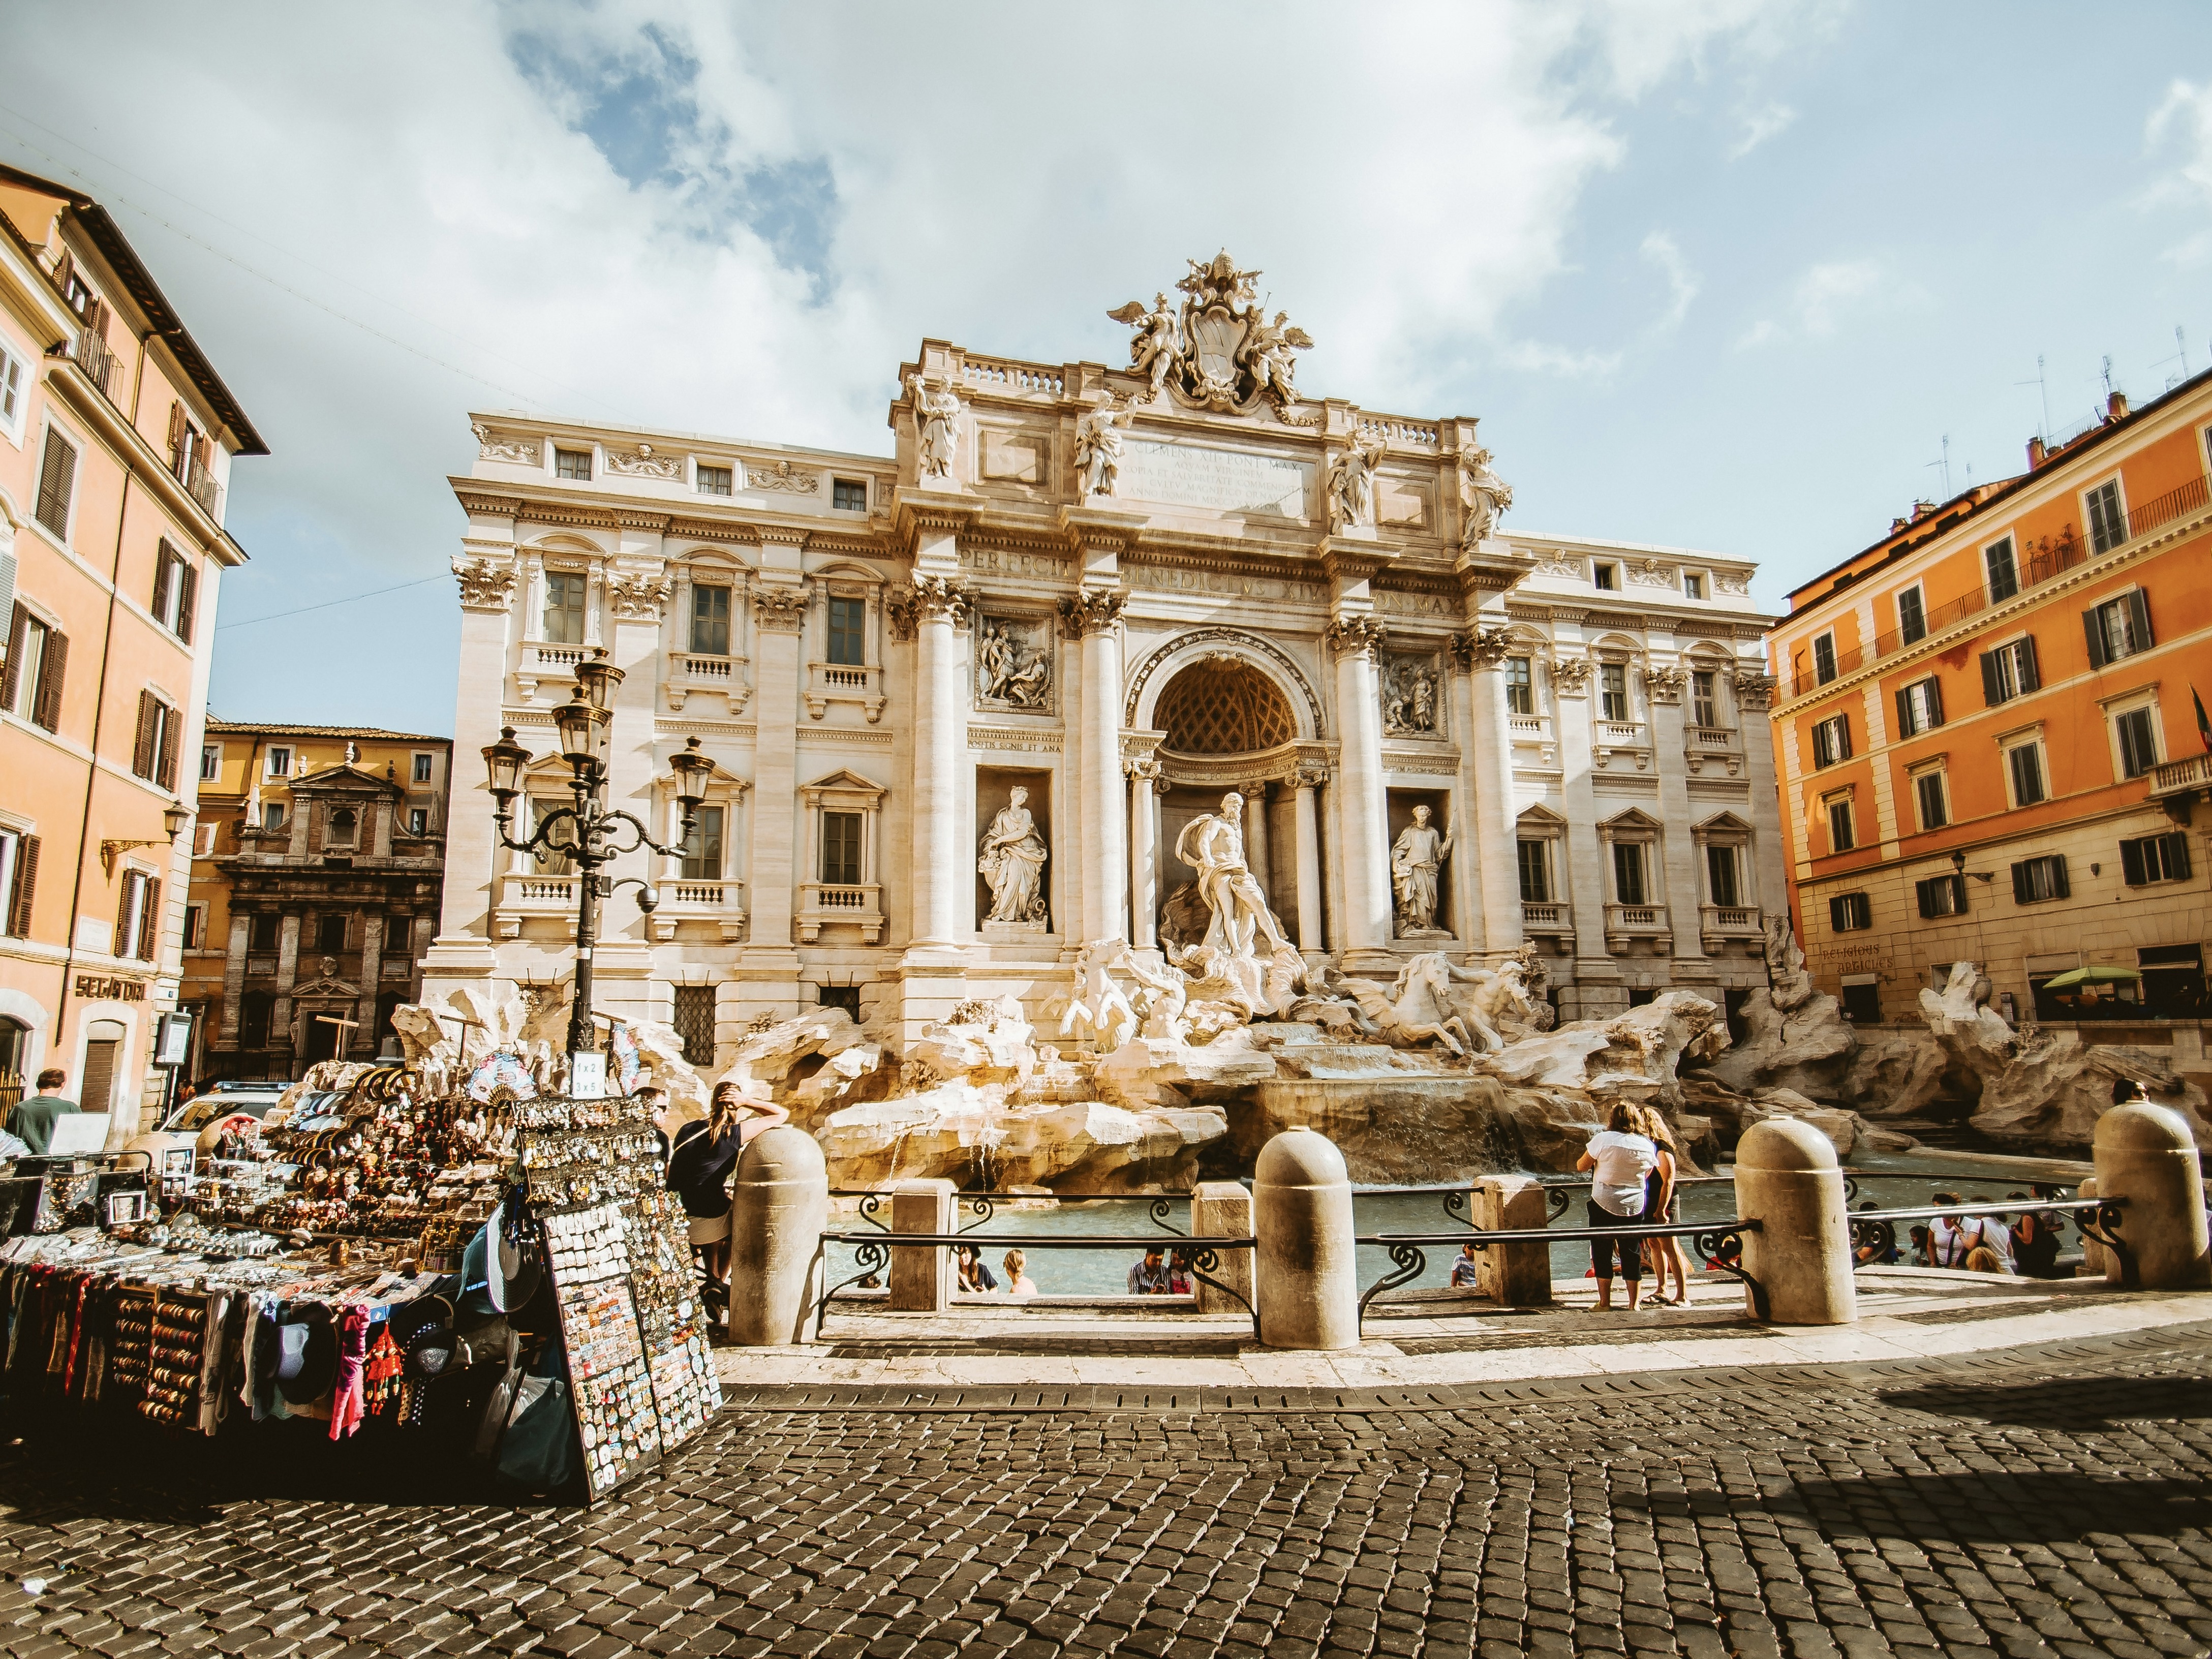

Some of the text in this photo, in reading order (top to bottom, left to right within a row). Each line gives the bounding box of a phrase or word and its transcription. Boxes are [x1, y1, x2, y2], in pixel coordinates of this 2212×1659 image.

[1134, 444, 1192, 459] CLEMENS
[1174, 461, 1264, 479] AQVAM VIRGINEM
[1124, 465, 1310, 495] COPIA ET SALVBRITATE COMMENDATAM
[1129, 486, 1158, 497] ANNO
[1161, 490, 1197, 502] DOMINI
[1150, 479, 1287, 502] CVLTV MAGNIFICO ORNAVIT
[960, 548, 1072, 577] PERFECIT
[1121, 565, 1266, 596] BENEDICTVS
[968, 741, 995, 749] POSITIS
[999, 742, 1023, 751] SGNIS
[1822, 943, 1880, 960] RELIGIOUS
[1836, 958, 1894, 973] ARTICLES
[577, 1063, 581, 1072] 1
[591, 1063, 596, 1072] 2
[576, 1082, 580, 1092] 3
[591, 1082, 596, 1092] 5
